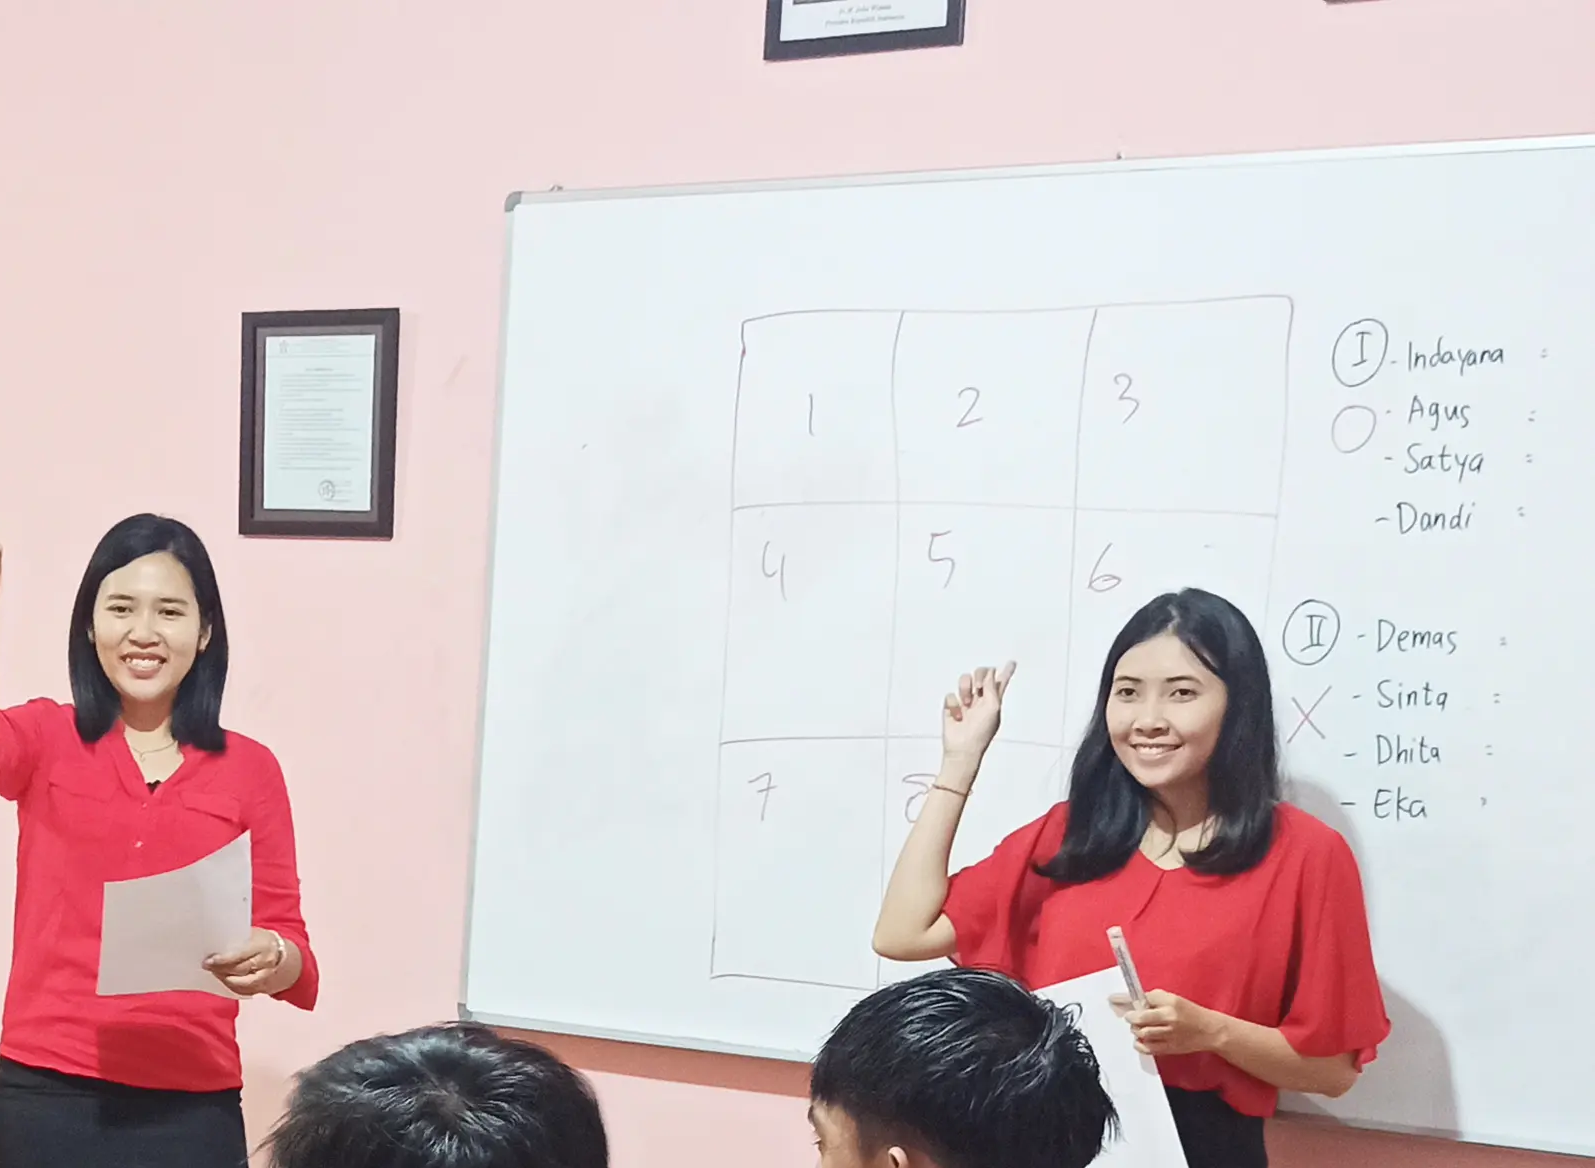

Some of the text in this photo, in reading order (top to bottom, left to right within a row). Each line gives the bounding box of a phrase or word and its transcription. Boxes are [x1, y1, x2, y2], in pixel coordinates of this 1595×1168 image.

[1407, 336, 1504, 376] Indayana
[807, 373, 1141, 436] 1 2 3
[1407, 394, 1471, 431] Agus
[1403, 442, 1485, 483] Satya
[1396, 501, 1476, 534] Dandi
[760, 530, 1124, 602] 4 5 6
[1377, 618, 1459, 655] Demas
[1376, 679, 1448, 712] Sinta
[1376, 733, 1441, 765] Dhita
[747, 771, 778, 822] 7
[1373, 786, 1428, 822] Eka
